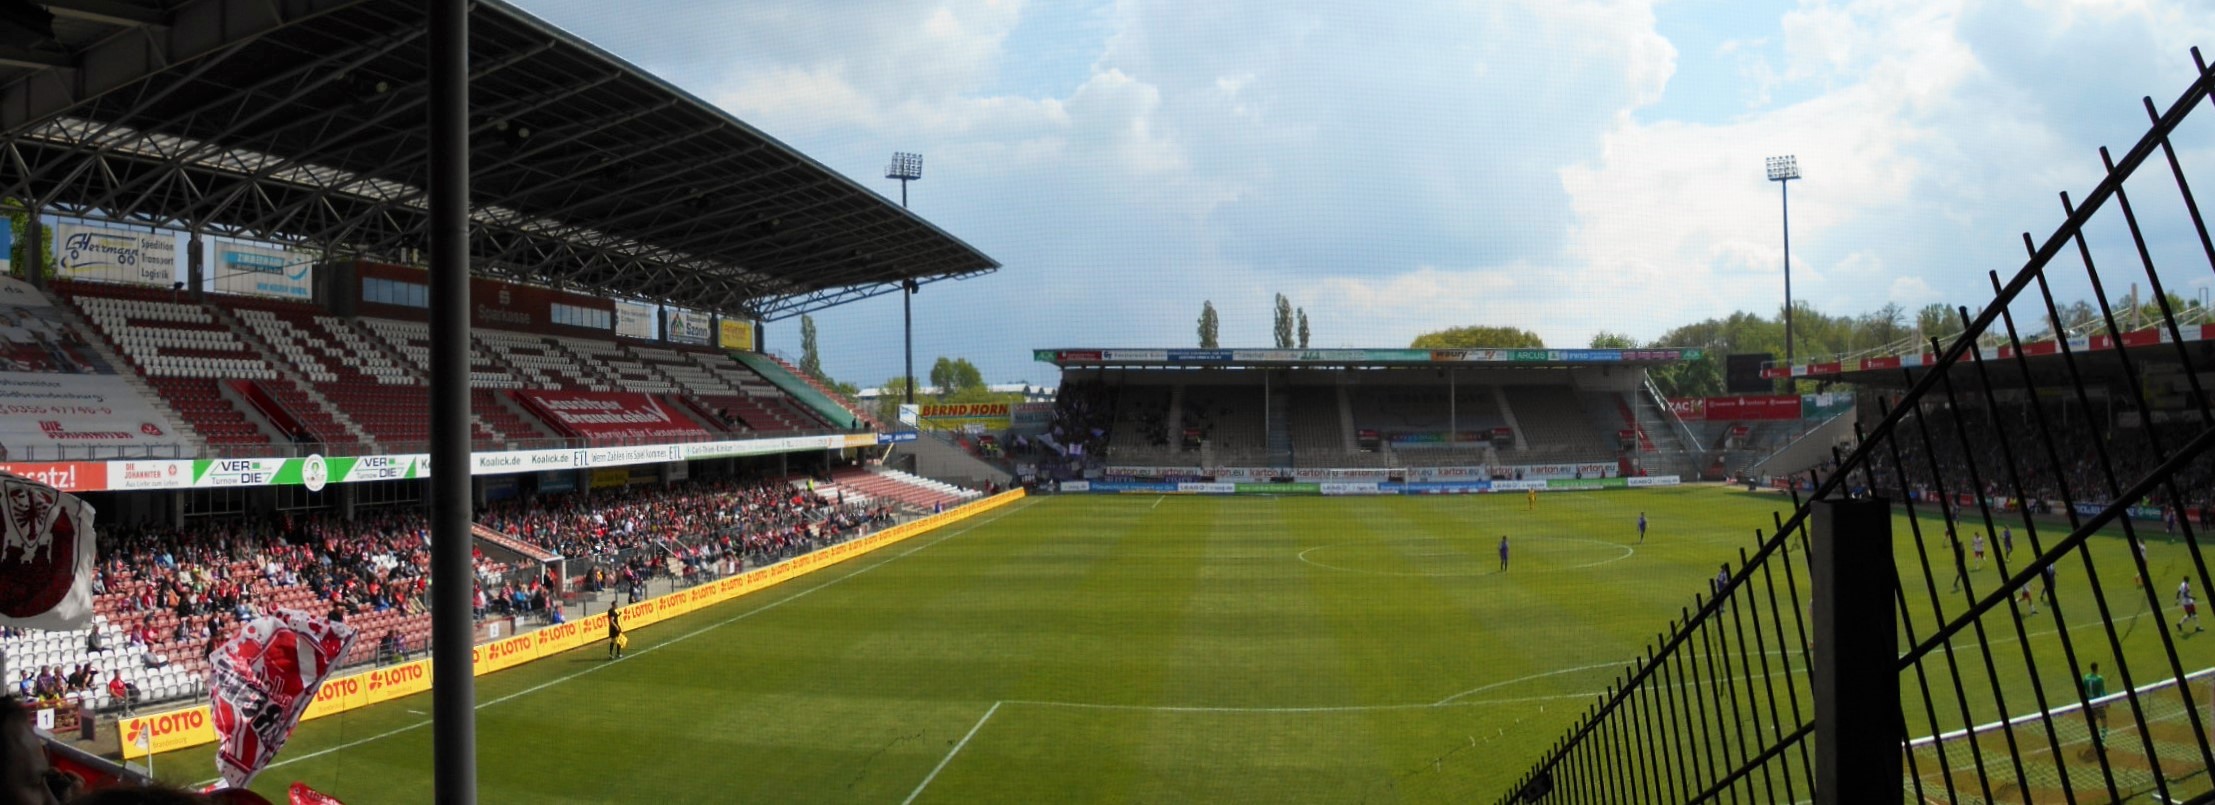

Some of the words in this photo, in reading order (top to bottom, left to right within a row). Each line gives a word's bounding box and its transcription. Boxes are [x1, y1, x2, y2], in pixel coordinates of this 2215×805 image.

[82, 232, 139, 256] Herrmann
[141, 239, 174, 251] Spedition
[142, 253, 174, 265] Transport
[141, 268, 169, 280] Logistik
[479, 304, 531, 324] Sparkasse
[686, 322, 708, 337] Szonn
[1436, 350, 1467, 360] waury
[1518, 351, 1545, 360] ARCUS
[535, 396, 623, 410] Lausitzer
[922, 404, 967, 417] BERND
[970, 403, 1009, 416] HORN
[553, 410, 661, 424] Braunkohle
[532, 454, 569, 464] Koalick.de
[574, 451, 589, 467] ETL
[669, 445, 681, 460] ETL
[221, 461, 250, 471] VER
[364, 458, 386, 467] VER
[480, 457, 520, 467] Koalick.de
[125, 470, 161, 479] JOHANNITER
[379, 468, 397, 478] DIE
[1531, 465, 1571, 474] karton.eu
[241, 473, 262, 484] DIE
[752, 571, 768, 583] LOTTO
[727, 578, 743, 591] LOTTO
[698, 585, 717, 600] LOTTO
[667, 593, 687, 608] LOTTO
[632, 602, 654, 618] LOTTO
[591, 613, 609, 630] LOT
[492, 625, 498, 636] 2
[549, 624, 576, 641] LOTTO
[500, 637, 531, 656] LOTTO
[384, 664, 422, 685] LOTTO
[316, 678, 358, 702] LOTTO
[43, 713, 49, 725] 1
[149, 710, 203, 737] LOTTO
